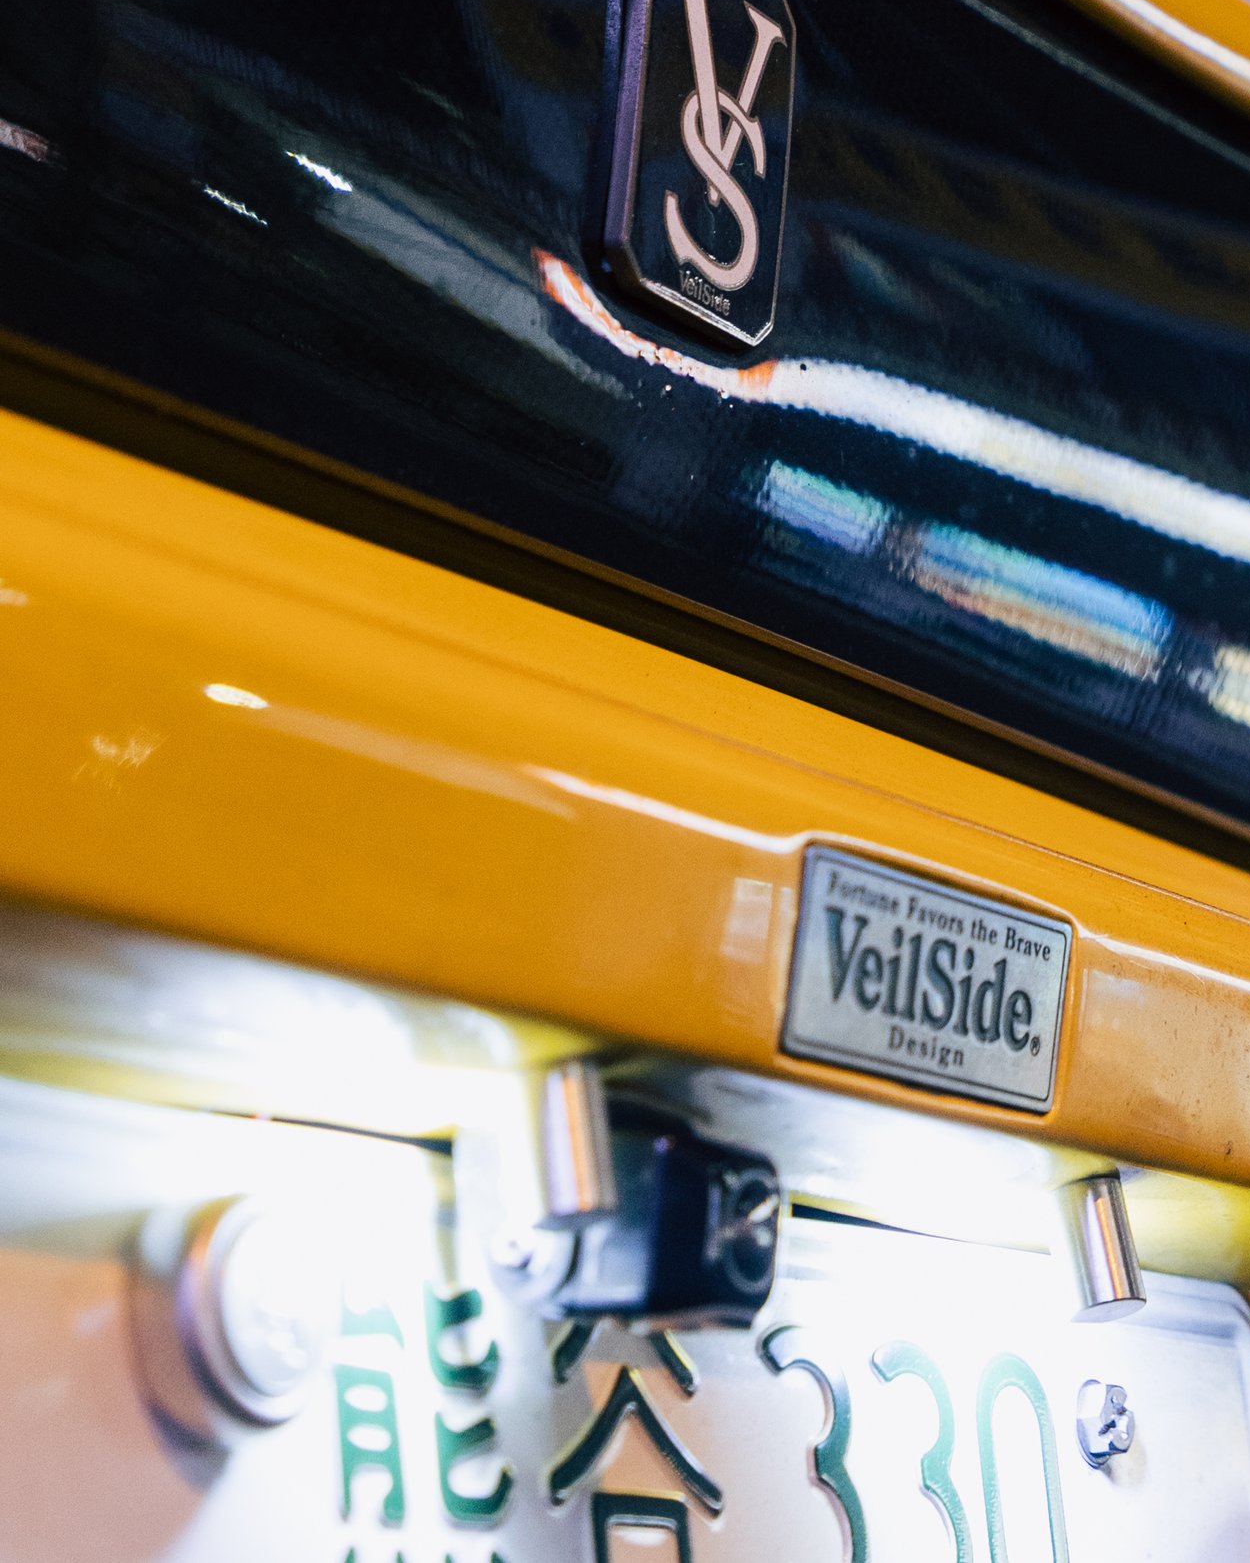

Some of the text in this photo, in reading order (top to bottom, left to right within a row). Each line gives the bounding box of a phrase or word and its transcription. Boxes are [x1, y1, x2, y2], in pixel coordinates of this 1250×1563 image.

[679, 269, 731, 316] VeilSide
[828, 870, 1051, 962] Fortune Favors the Brave
[888, 1024, 965, 1068] Design
[756, 1322, 1070, 1563] 330
